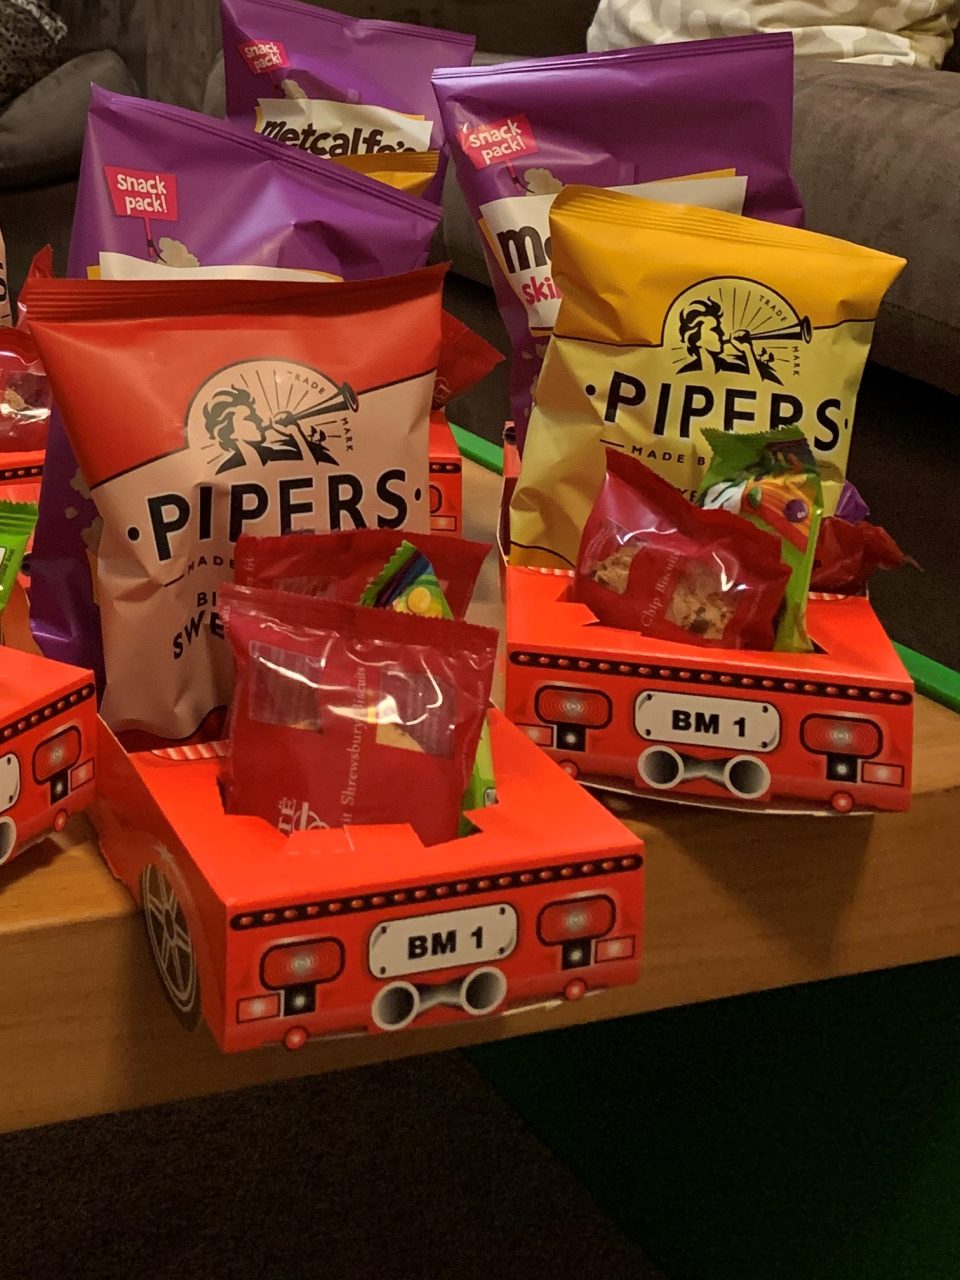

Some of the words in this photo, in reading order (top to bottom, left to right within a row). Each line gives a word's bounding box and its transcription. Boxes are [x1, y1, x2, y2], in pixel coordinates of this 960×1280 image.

[245, 42, 280, 58] snack
[261, 120, 416, 158] metcalf'
[469, 120, 522, 148] snack
[481, 136, 526, 165] pack!
[117, 174, 167, 195] snack
[125, 194, 168, 215] pack!
[759, 295, 788, 322] TRADE
[792, 346, 800, 376] MARK
[287, 370, 326, 395] TRADE
[604, 371, 841, 451] PIPERS
[341, 417, 353, 452] MARK
[631, 445, 685, 464] MADE
[147, 469, 408, 561] PIPERS
[641, 597, 663, 627] Chip
[173, 611, 225, 659] SWE
[672, 709, 720, 734] BM
[733, 716, 746, 737] 1
[341, 720, 367, 806] Shrewsbury
[408, 929, 457, 960] BM
[470, 926, 483, 949] 1
